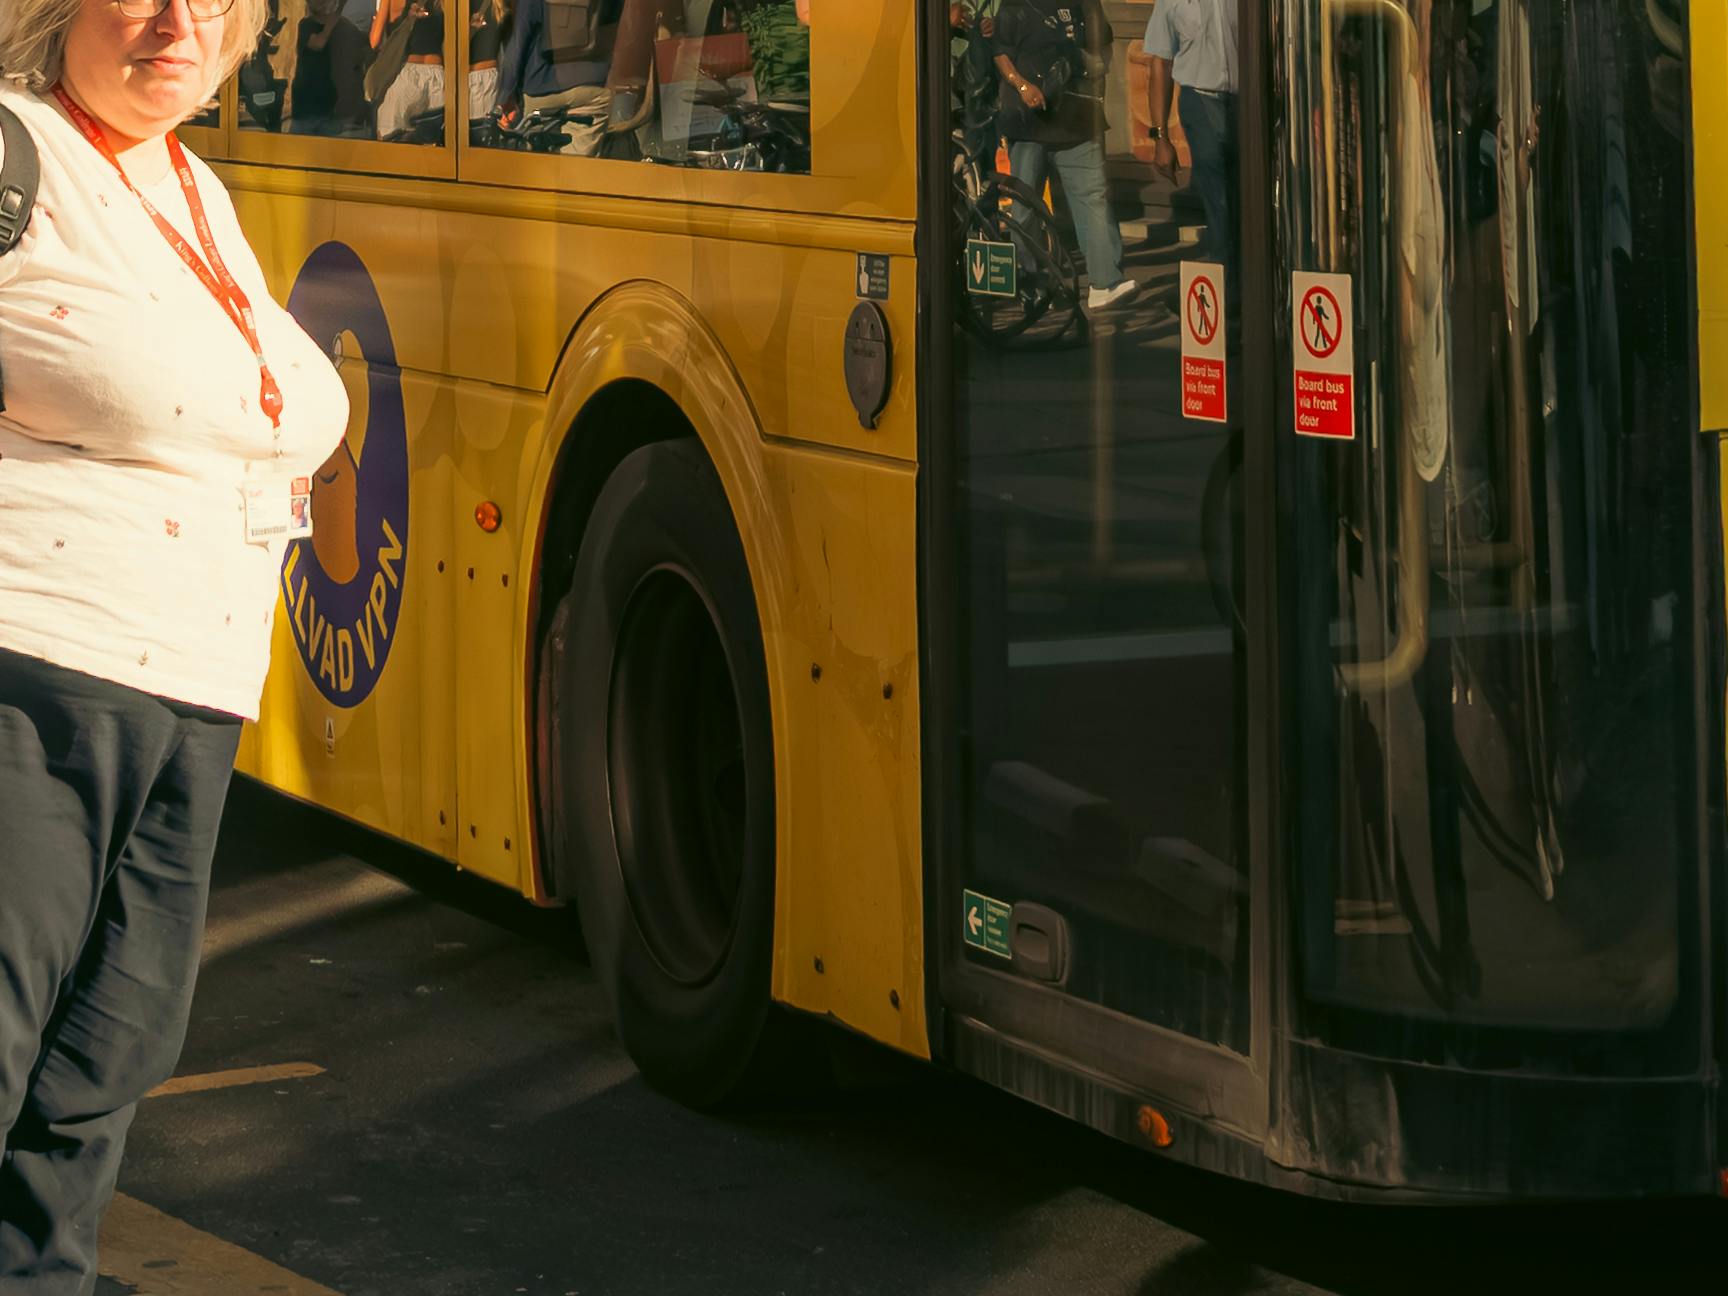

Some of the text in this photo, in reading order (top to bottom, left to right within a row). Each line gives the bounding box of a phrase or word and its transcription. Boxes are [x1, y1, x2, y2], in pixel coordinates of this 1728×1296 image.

[1299, 377, 1344, 394] Board bus
[1299, 397, 1338, 411] via front
[1299, 413, 1319, 427] door
[285, 518, 403, 692] LLVAD VPN
